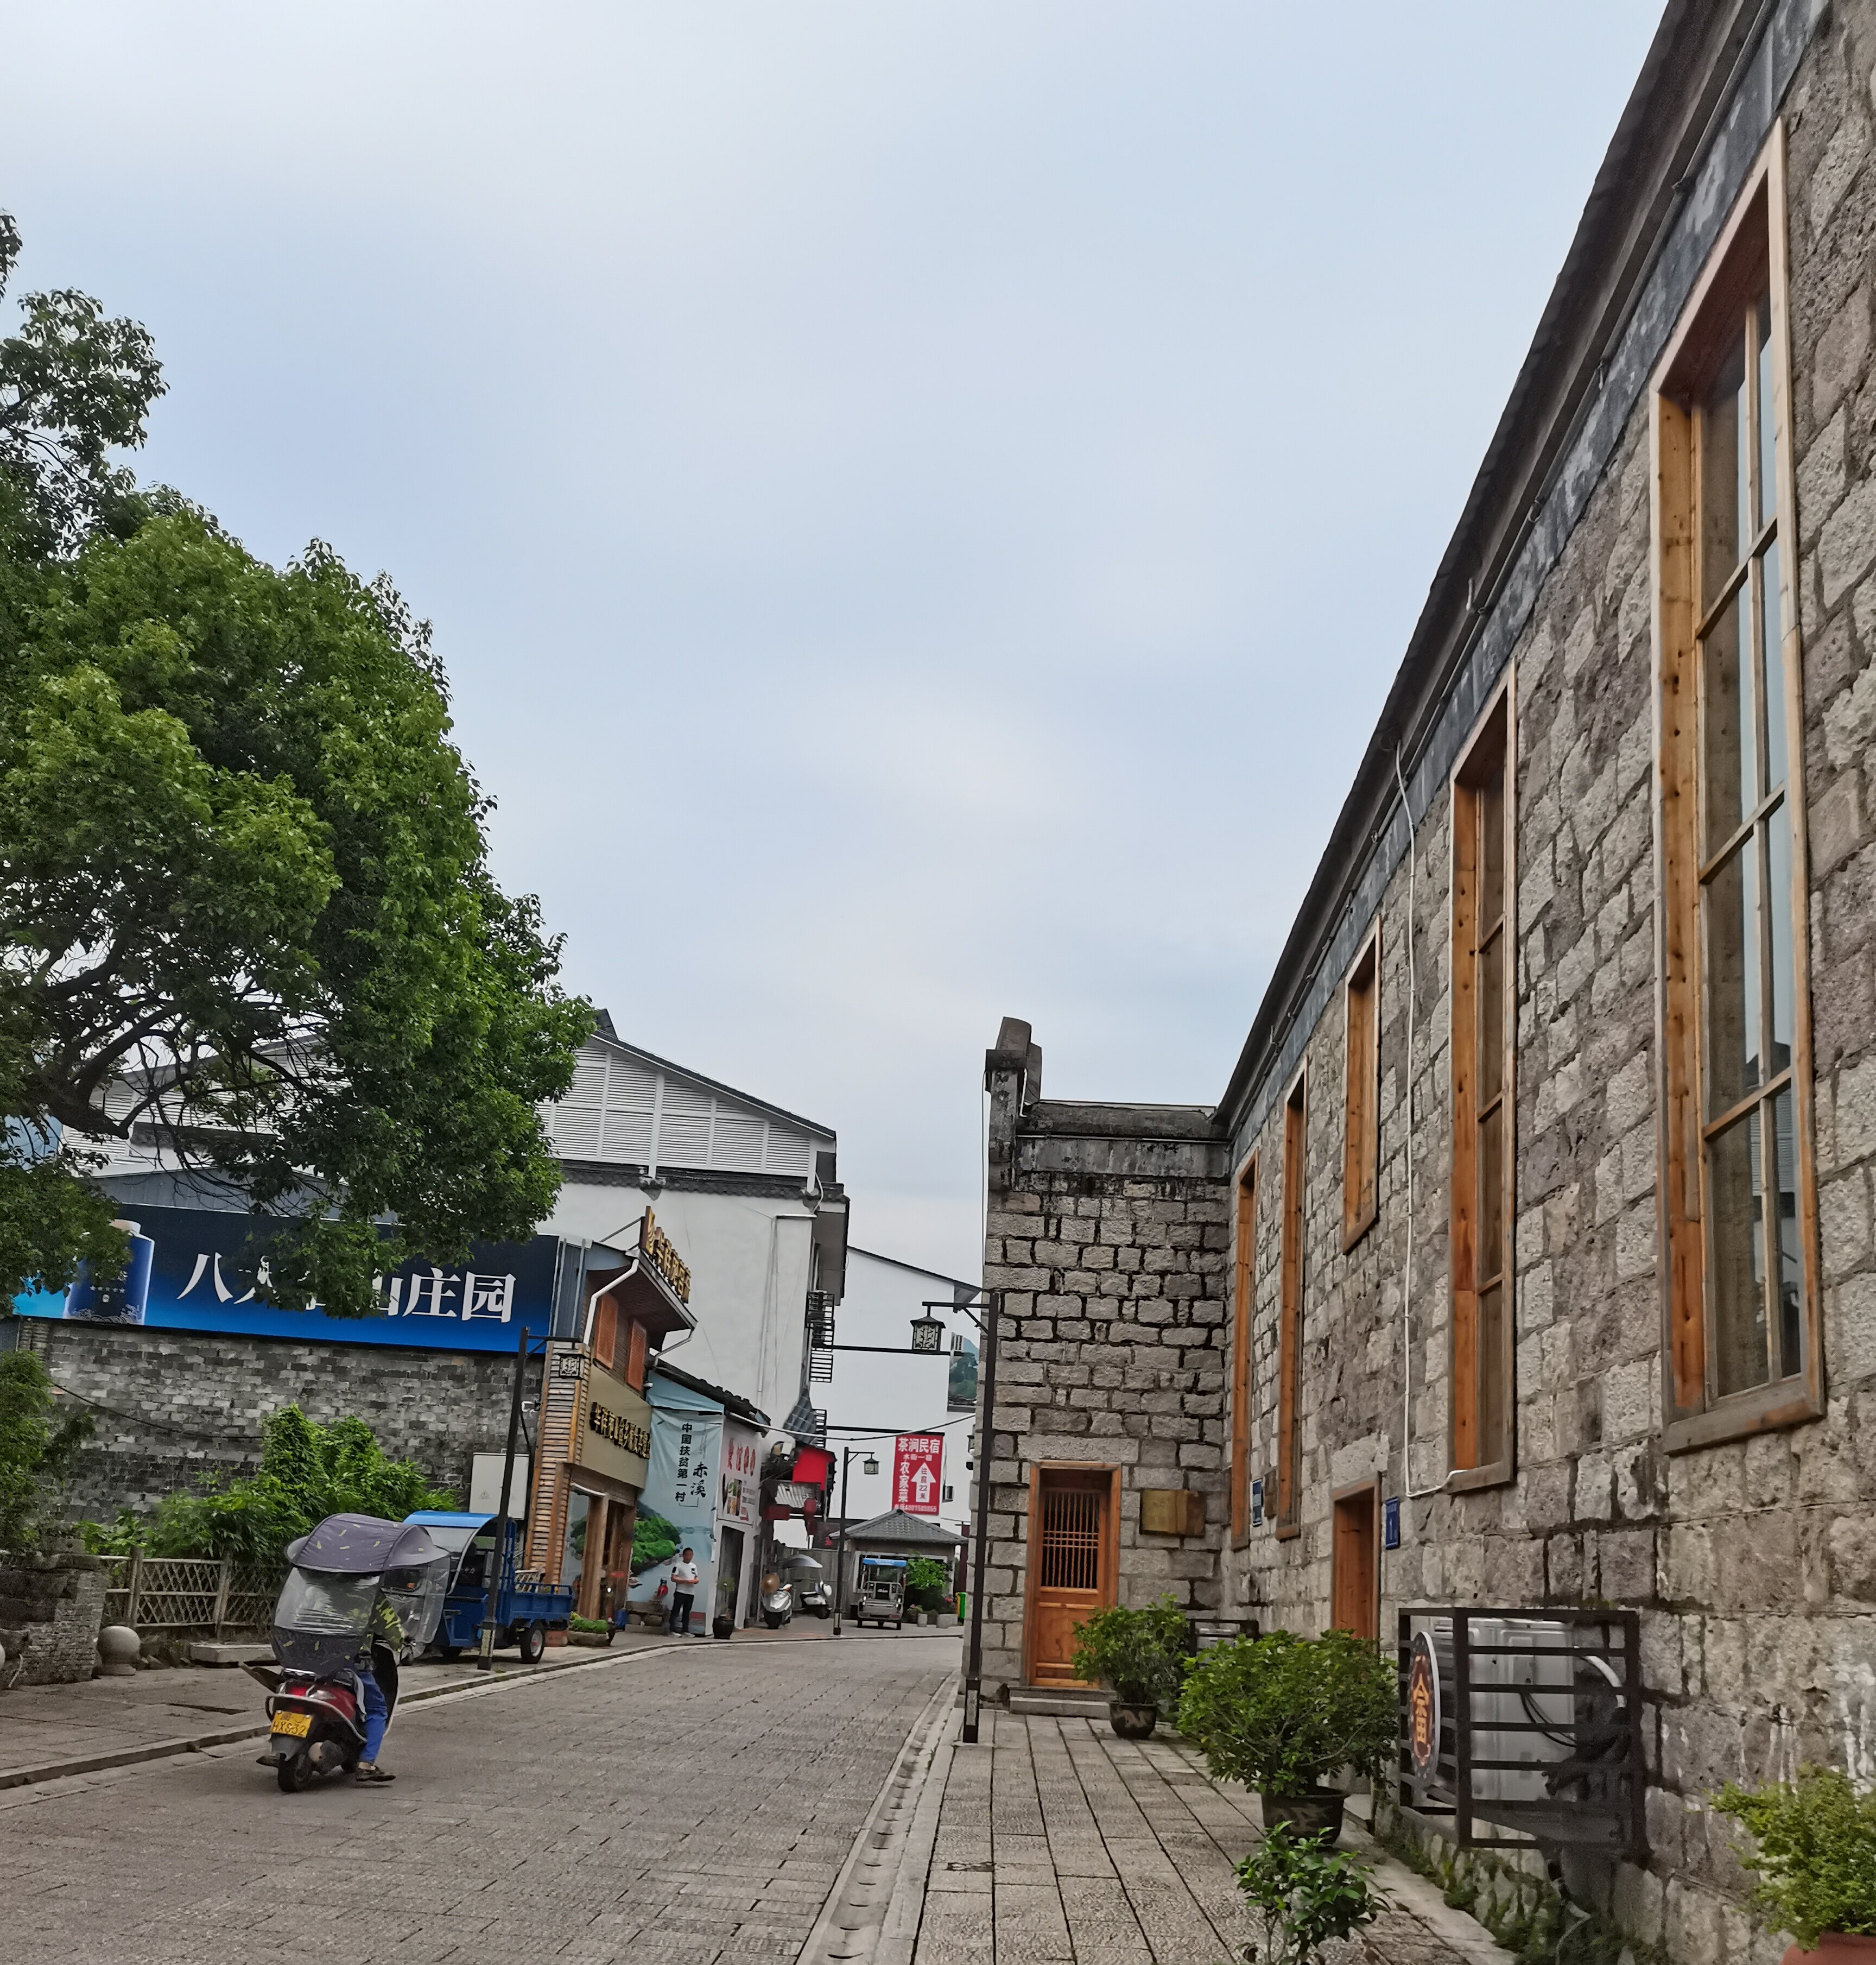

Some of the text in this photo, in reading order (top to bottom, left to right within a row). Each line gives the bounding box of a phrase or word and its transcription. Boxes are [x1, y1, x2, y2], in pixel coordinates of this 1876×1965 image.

[675, 1423, 692, 1502] 中国扶贫第一村
[690, 1461, 708, 1498] 赤溪
[898, 1462, 910, 1503] 农家菜
[272, 1720, 307, 1736] HX832
